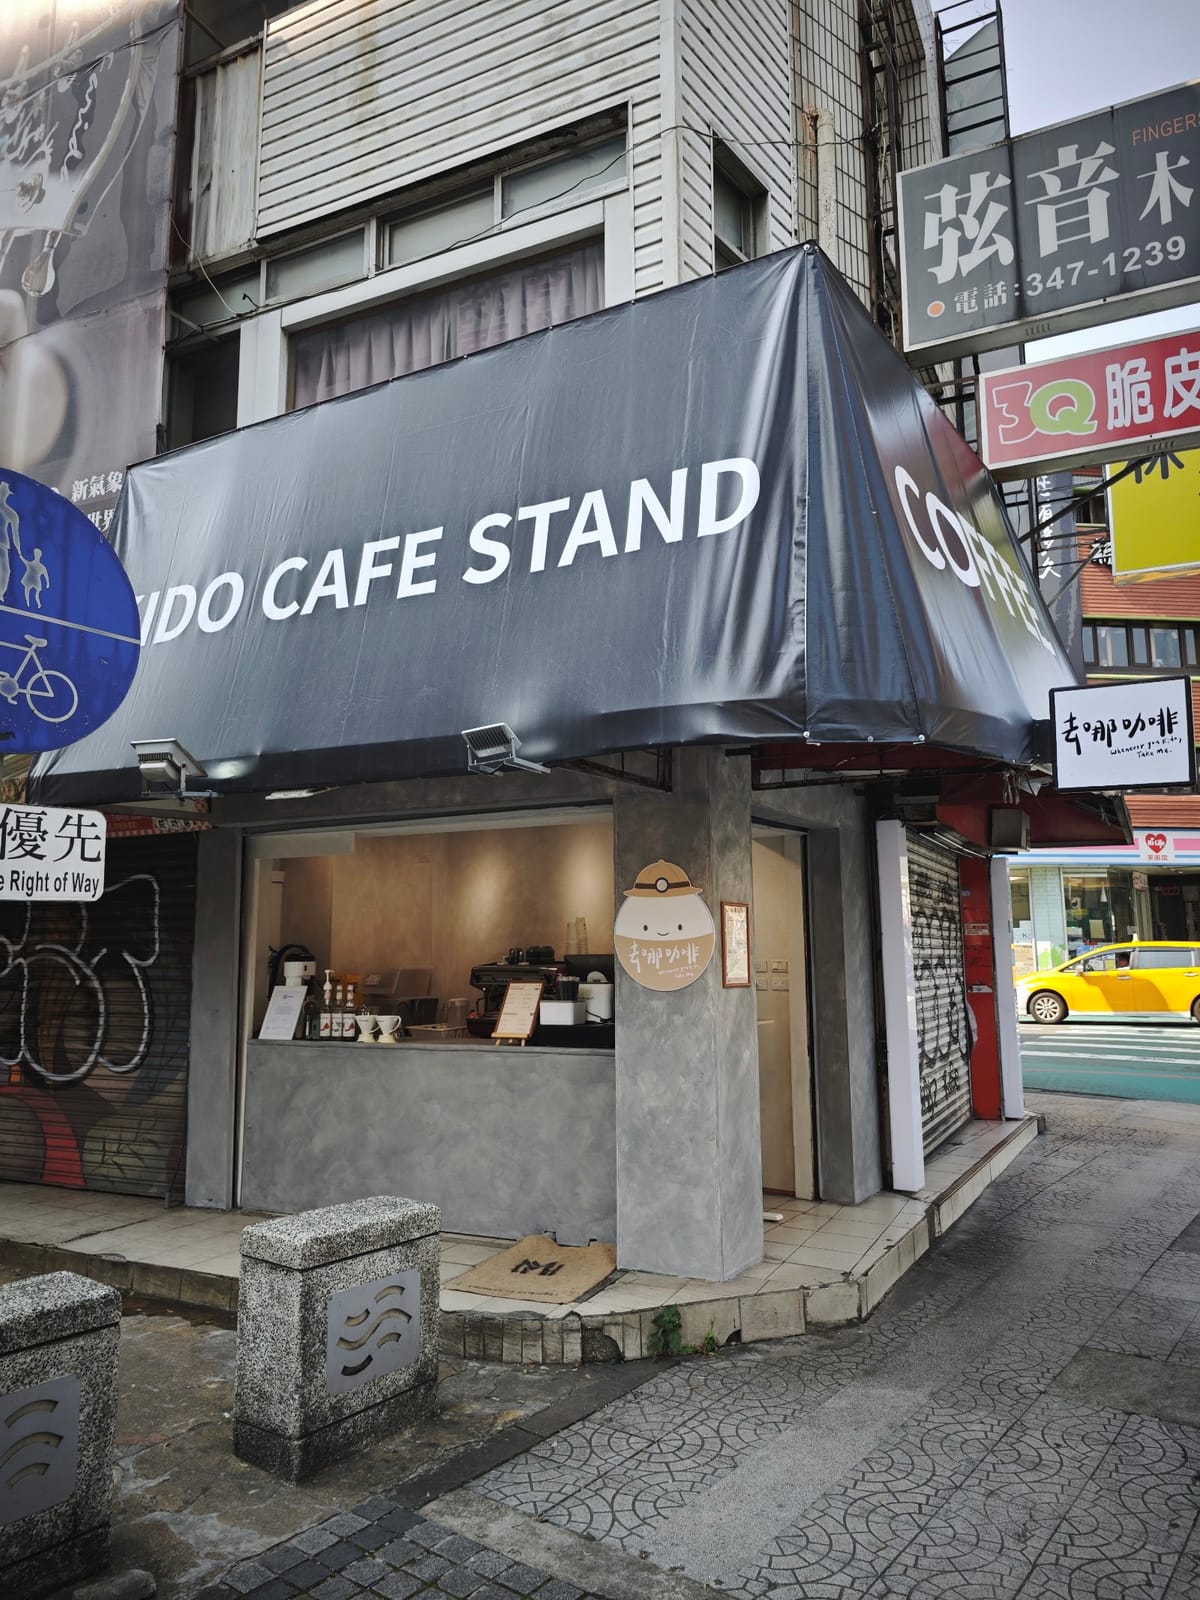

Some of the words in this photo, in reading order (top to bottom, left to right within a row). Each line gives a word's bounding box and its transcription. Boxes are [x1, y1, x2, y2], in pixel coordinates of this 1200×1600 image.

[1132, 112, 1200, 146] FINGER
[1105, 347, 1200, 431] 脆皮
[136, 571, 245, 648] IDO
[262, 526, 444, 622] CAFE
[462, 456, 761, 584] STAND
[894, 464, 1057, 657] COFFEE
[1061, 706, 1179, 756] 去哪咖啡
[0, 807, 102, 863] 優先
[9, 869, 50, 898] Right
[53, 871, 69, 893] of
[72, 871, 100, 899] Way
